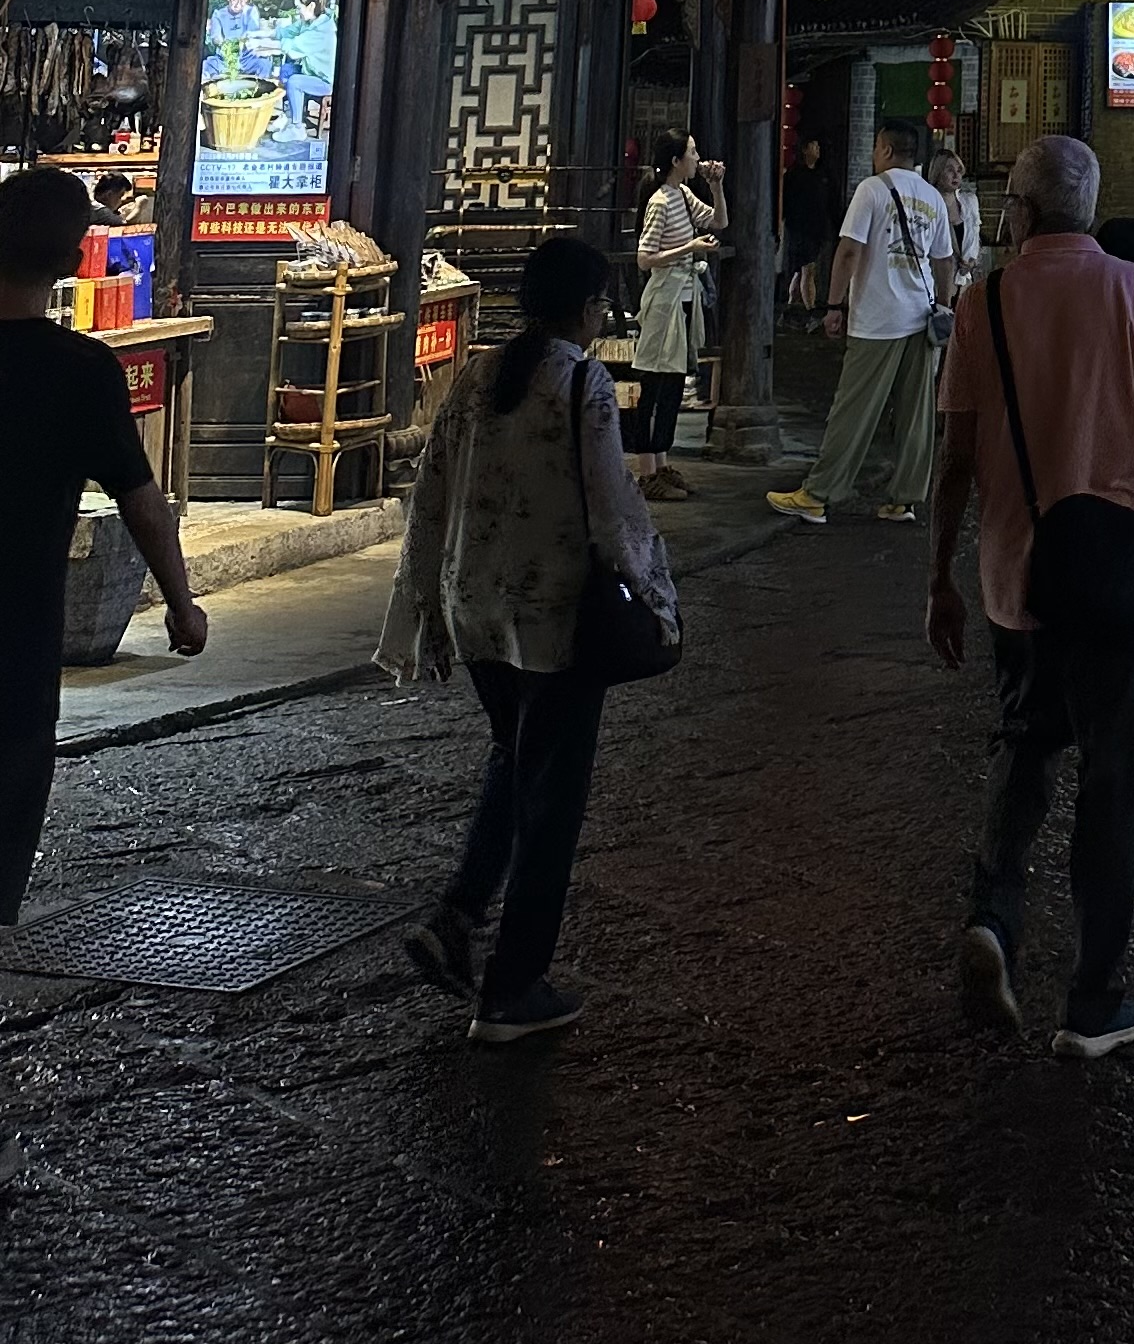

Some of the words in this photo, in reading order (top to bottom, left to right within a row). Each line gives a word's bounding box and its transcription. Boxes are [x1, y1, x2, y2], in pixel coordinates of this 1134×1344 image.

[269, 174, 323, 190] 瞿大掌柜
[200, 202, 326, 216] 两个巴掌做出来的东西
